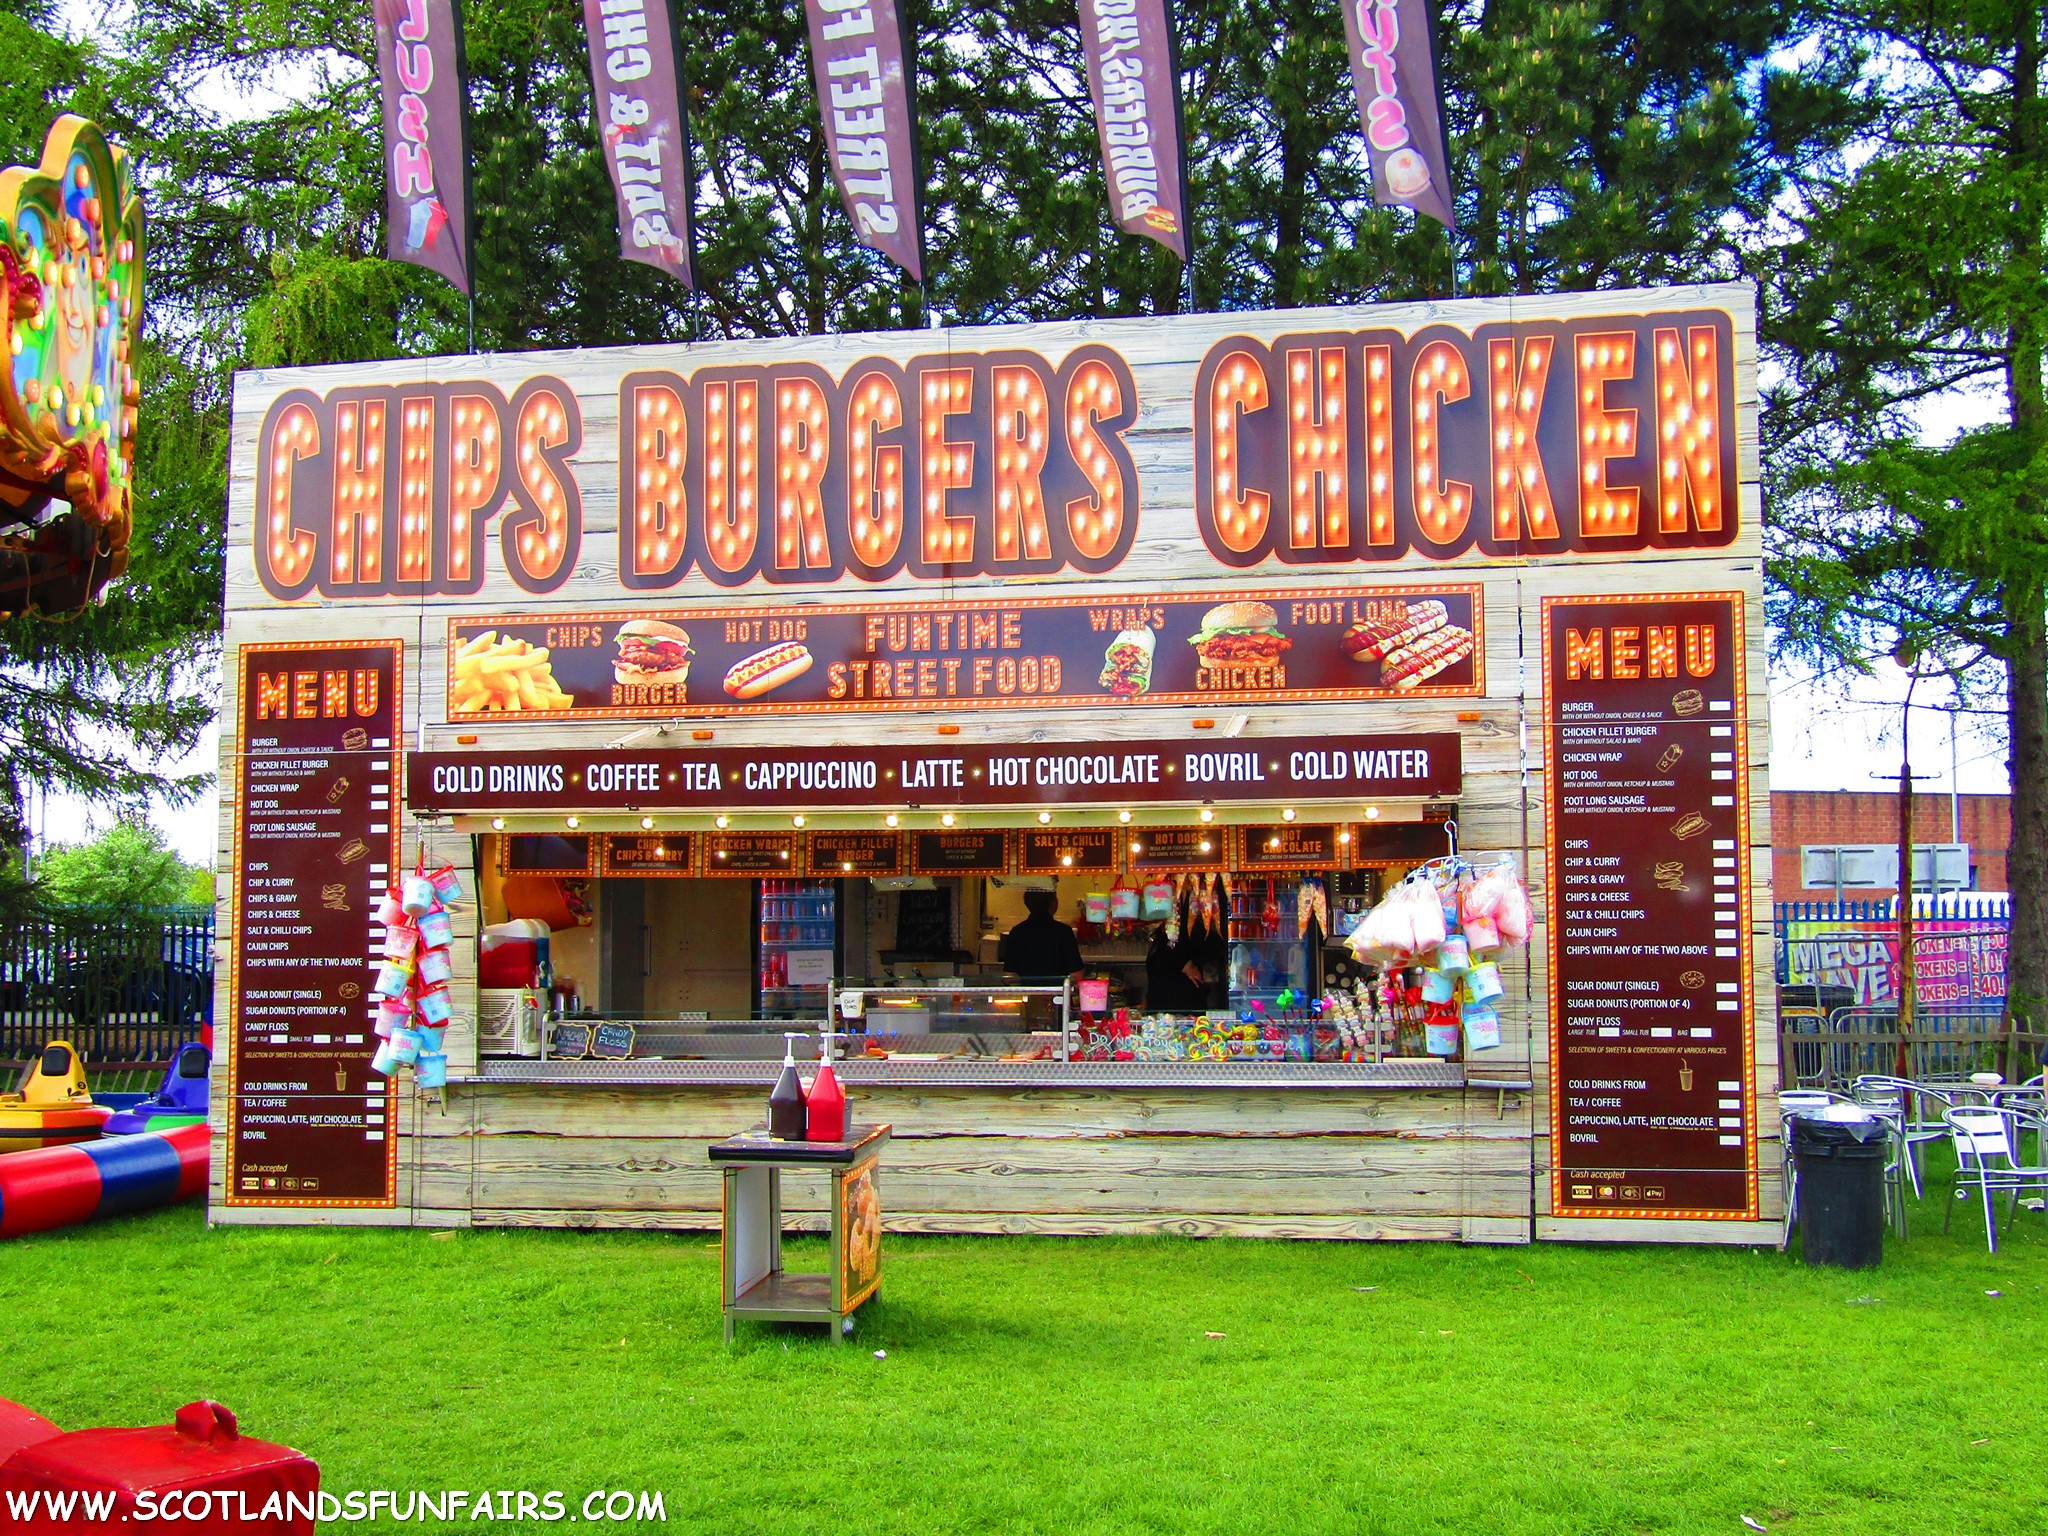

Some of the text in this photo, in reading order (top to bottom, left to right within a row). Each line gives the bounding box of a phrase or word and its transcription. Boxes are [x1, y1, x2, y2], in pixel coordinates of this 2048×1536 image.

[266, 324, 1723, 588] CHIPS BURGERS CHICKEN
[1290, 599, 1408, 626] FOOT LONG
[1088, 606, 1166, 632] WRAPS
[724, 619, 809, 644] HOT DOG
[865, 611, 1022, 653] FUNTIME
[546, 625, 603, 650] CHIPS
[1566, 624, 1715, 680] MENU
[827, 654, 1062, 700] STREET FOOD
[1195, 665, 1287, 691] CHICKEN
[257, 669, 379, 720] MENU
[610, 682, 688, 705] BURGER
[1562, 702, 1593, 712] BURGER
[1562, 727, 1657, 737] CHICKEN FILLET BURGER
[252, 738, 278, 747] BURGER
[1563, 753, 1622, 762] CHICKEN WRAP
[251, 760, 328, 769] CHICKEN FILLET BURGER
[432, 750, 1429, 793] COLD DRINKS COFFEE TEA CAPPUCCINO LATTE HOT CHOCOLATE BOVRIL COLD WATER
[1563, 771, 1597, 780] HOT DOG
[251, 784, 299, 793] CHICKEN WRAP
[251, 800, 278, 809] HOT DOG
[1564, 796, 1645, 805] FOOT LONG SAUSAGE
[250, 823, 316, 832] FOOT LONG SAUSAGE
[1155, 833, 1203, 844] HOT DOGS
[1282, 830, 1301, 840] HOT
[637, 839, 664, 849] CHIPS
[713, 839, 790, 849] CHICKEN WRAPS
[817, 838, 894, 849] CHICKEN FILLET
[940, 837, 984, 848] BURGERS
[1034, 835, 1105, 846] SALT & CHILLI
[1565, 840, 1588, 849] CHIPS
[1263, 841, 1321, 853] CHOCOLATE
[616, 851, 643, 861] CHIPS
[653, 851, 683, 862] CURRY
[836, 850, 874, 860] BURGER
[1055, 848, 1084, 858] CHIPS
[1565, 857, 1620, 866] CHIP & CURRY
[1565, 875, 1625, 884] CHIPS & GRAVY
[1565, 893, 1629, 902] CHIPS & CHEESE
[1566, 910, 1645, 919] SALT & CHILLI CHIPS
[1566, 928, 1617, 937] CAJUN CHIPS
[1566, 946, 1708, 955] CHIPS WITH ANY OF THE TWO ABOVE
[1793, 930, 1891, 972] MEGA
[1567, 981, 1659, 991] SUGAR DONUT (SINGLE)
[1567, 999, 1690, 1009] SUGAR DONUTS (PORTION OF 4)
[1568, 1017, 1620, 1026] CANDY FLOSS
[601, 1026, 629, 1038] CANDY
[598, 1036, 628, 1048] FLOSS
[1569, 1080, 1646, 1089] COLD DRINKS FROM
[1569, 1098, 1621, 1107] TEA / COFFEE
[1569, 1117, 1713, 1126] CAPPUCCINO, LATTE, HOT CHOCOLATE
[1570, 1134, 1598, 1143] BOVRIL
[242, 1164, 288, 1174] Cash accepted
[1570, 1170, 1625, 1180] Cash accepted
